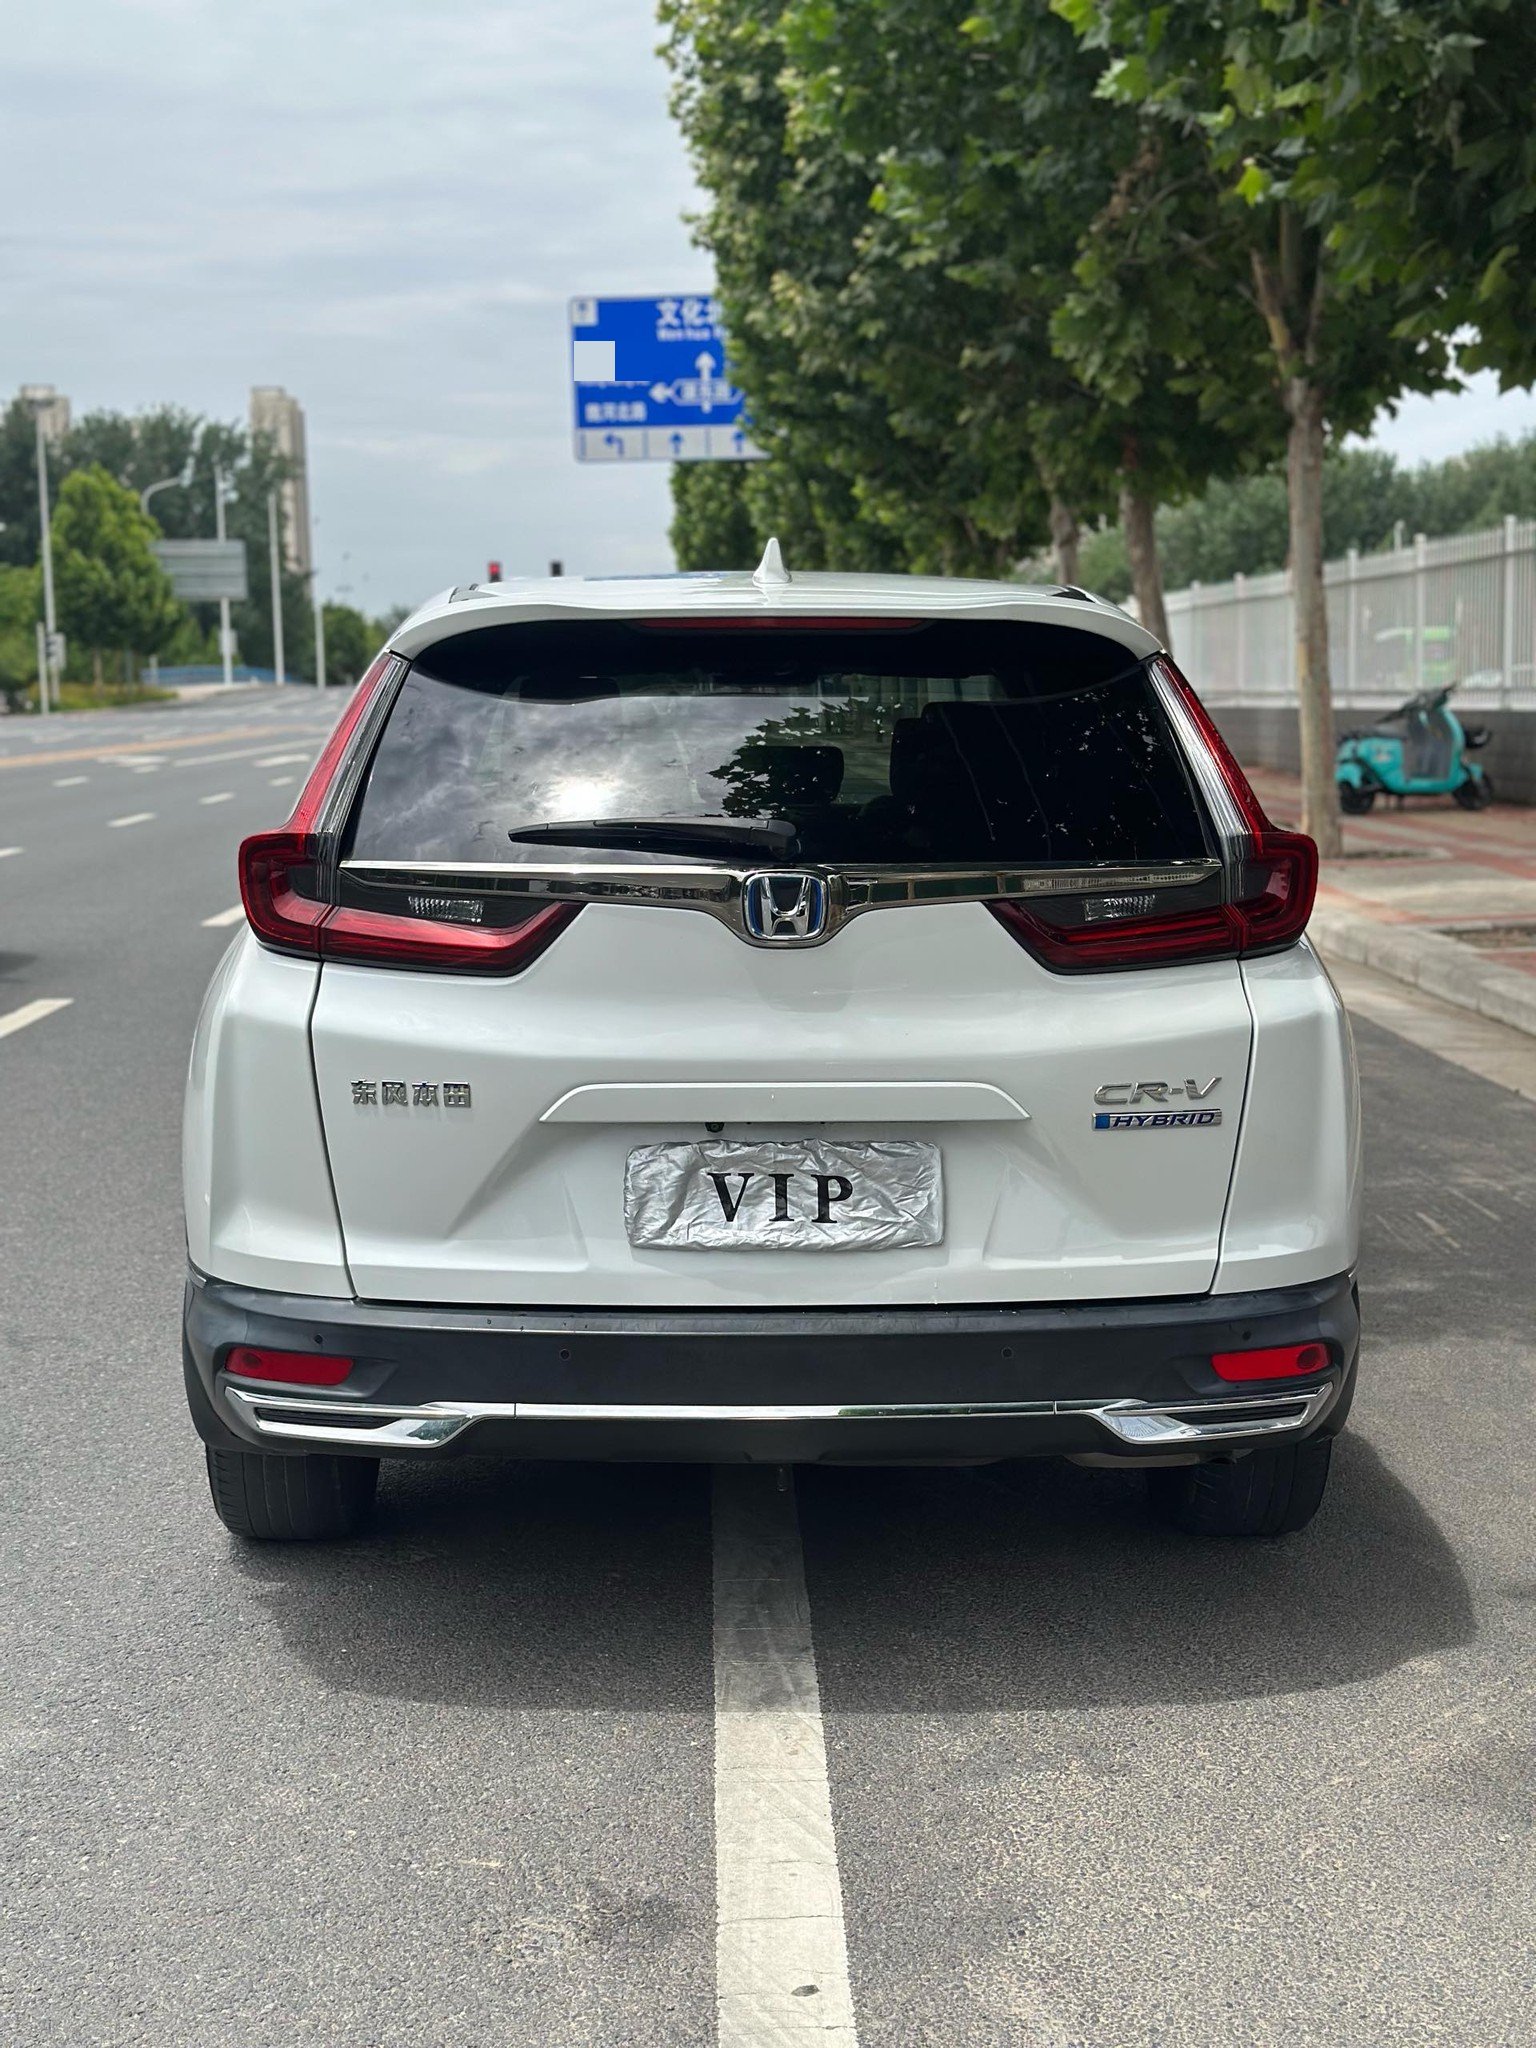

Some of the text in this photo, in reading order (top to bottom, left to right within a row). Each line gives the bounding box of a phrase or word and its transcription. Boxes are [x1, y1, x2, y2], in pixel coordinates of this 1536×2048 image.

[350, 1079, 471, 1108] 东风本田
[1094, 1077, 1222, 1105] CR-V
[1113, 1112, 1215, 1127] HYBRID
[707, 1172, 853, 1224] VIP
